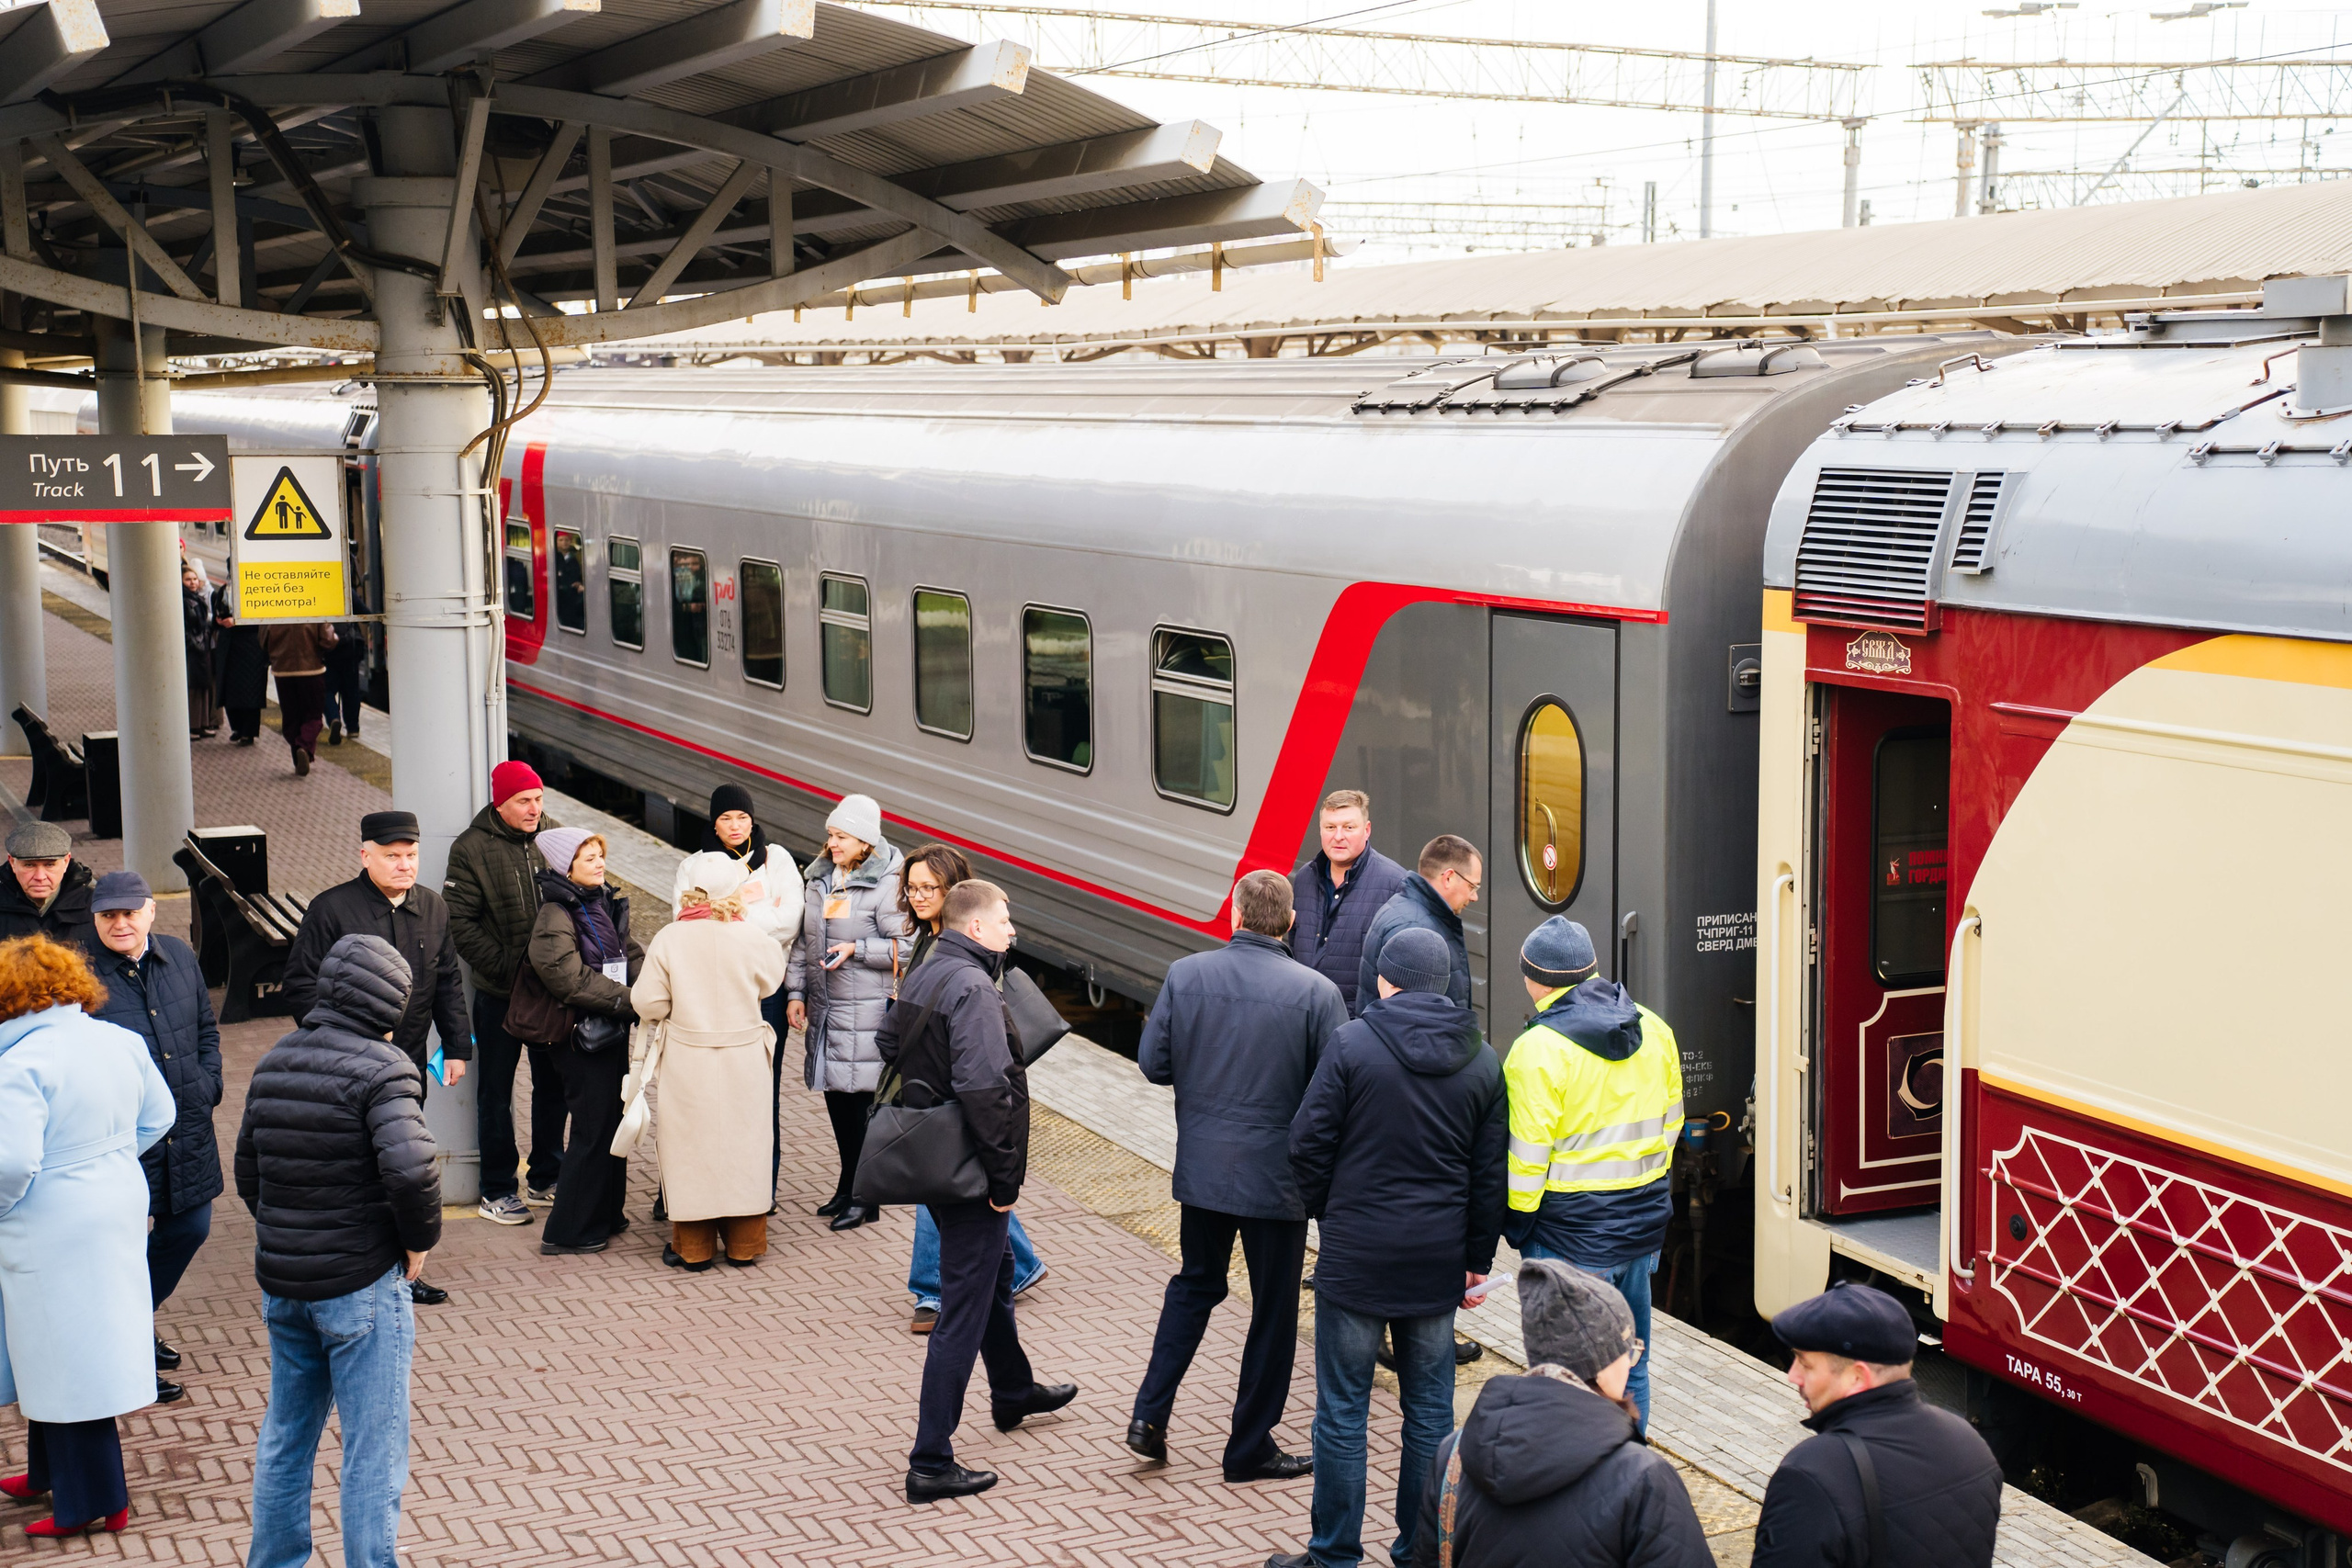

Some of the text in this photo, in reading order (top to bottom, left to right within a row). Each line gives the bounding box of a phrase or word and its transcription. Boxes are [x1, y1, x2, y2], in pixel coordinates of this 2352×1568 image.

[29, 454, 90, 478] Путь
[102, 453, 162, 497] 11
[32, 482, 85, 497] Track
[244, 569, 331, 580] Не оставляйте
[244, 582, 304, 595] детей без
[245, 596, 317, 609] присмотра!
[718, 609, 731, 630] 076
[717, 630, 735, 653] 33274
[1696, 924, 1753, 940] ТЧПРИГ-11
[1696, 939, 1734, 953] СВЕРД
[1682, 1050, 1703, 1061] ТО-2
[2006, 1353, 2042, 1385] ТАРА
[2066, 1388, 2075, 1400] 30
[2076, 1392, 2083, 1403] Т
